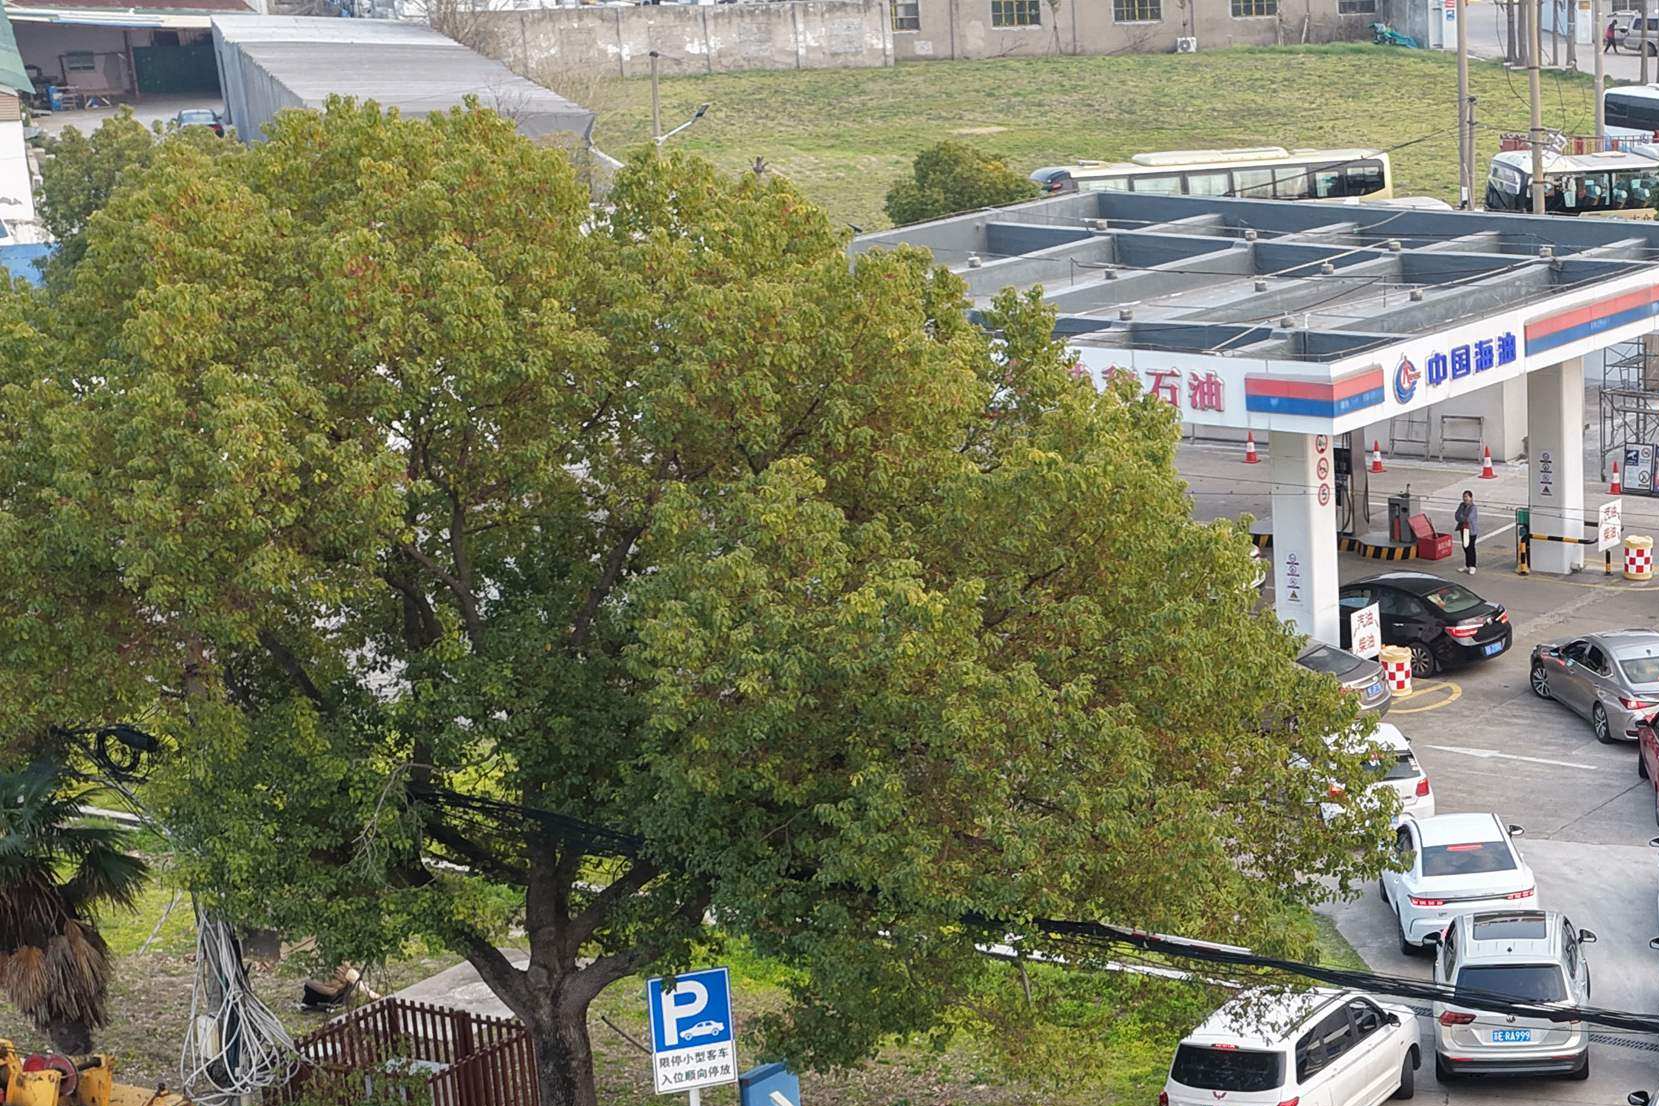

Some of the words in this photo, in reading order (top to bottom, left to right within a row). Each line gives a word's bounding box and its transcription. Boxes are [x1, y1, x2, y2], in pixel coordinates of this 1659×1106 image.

[1428, 332, 1516, 385] 中国海油
[661, 980, 708, 1046] P
[659, 1047, 728, 1069] 限停小型客车
[661, 1064, 730, 1086] 入位顺向停放
